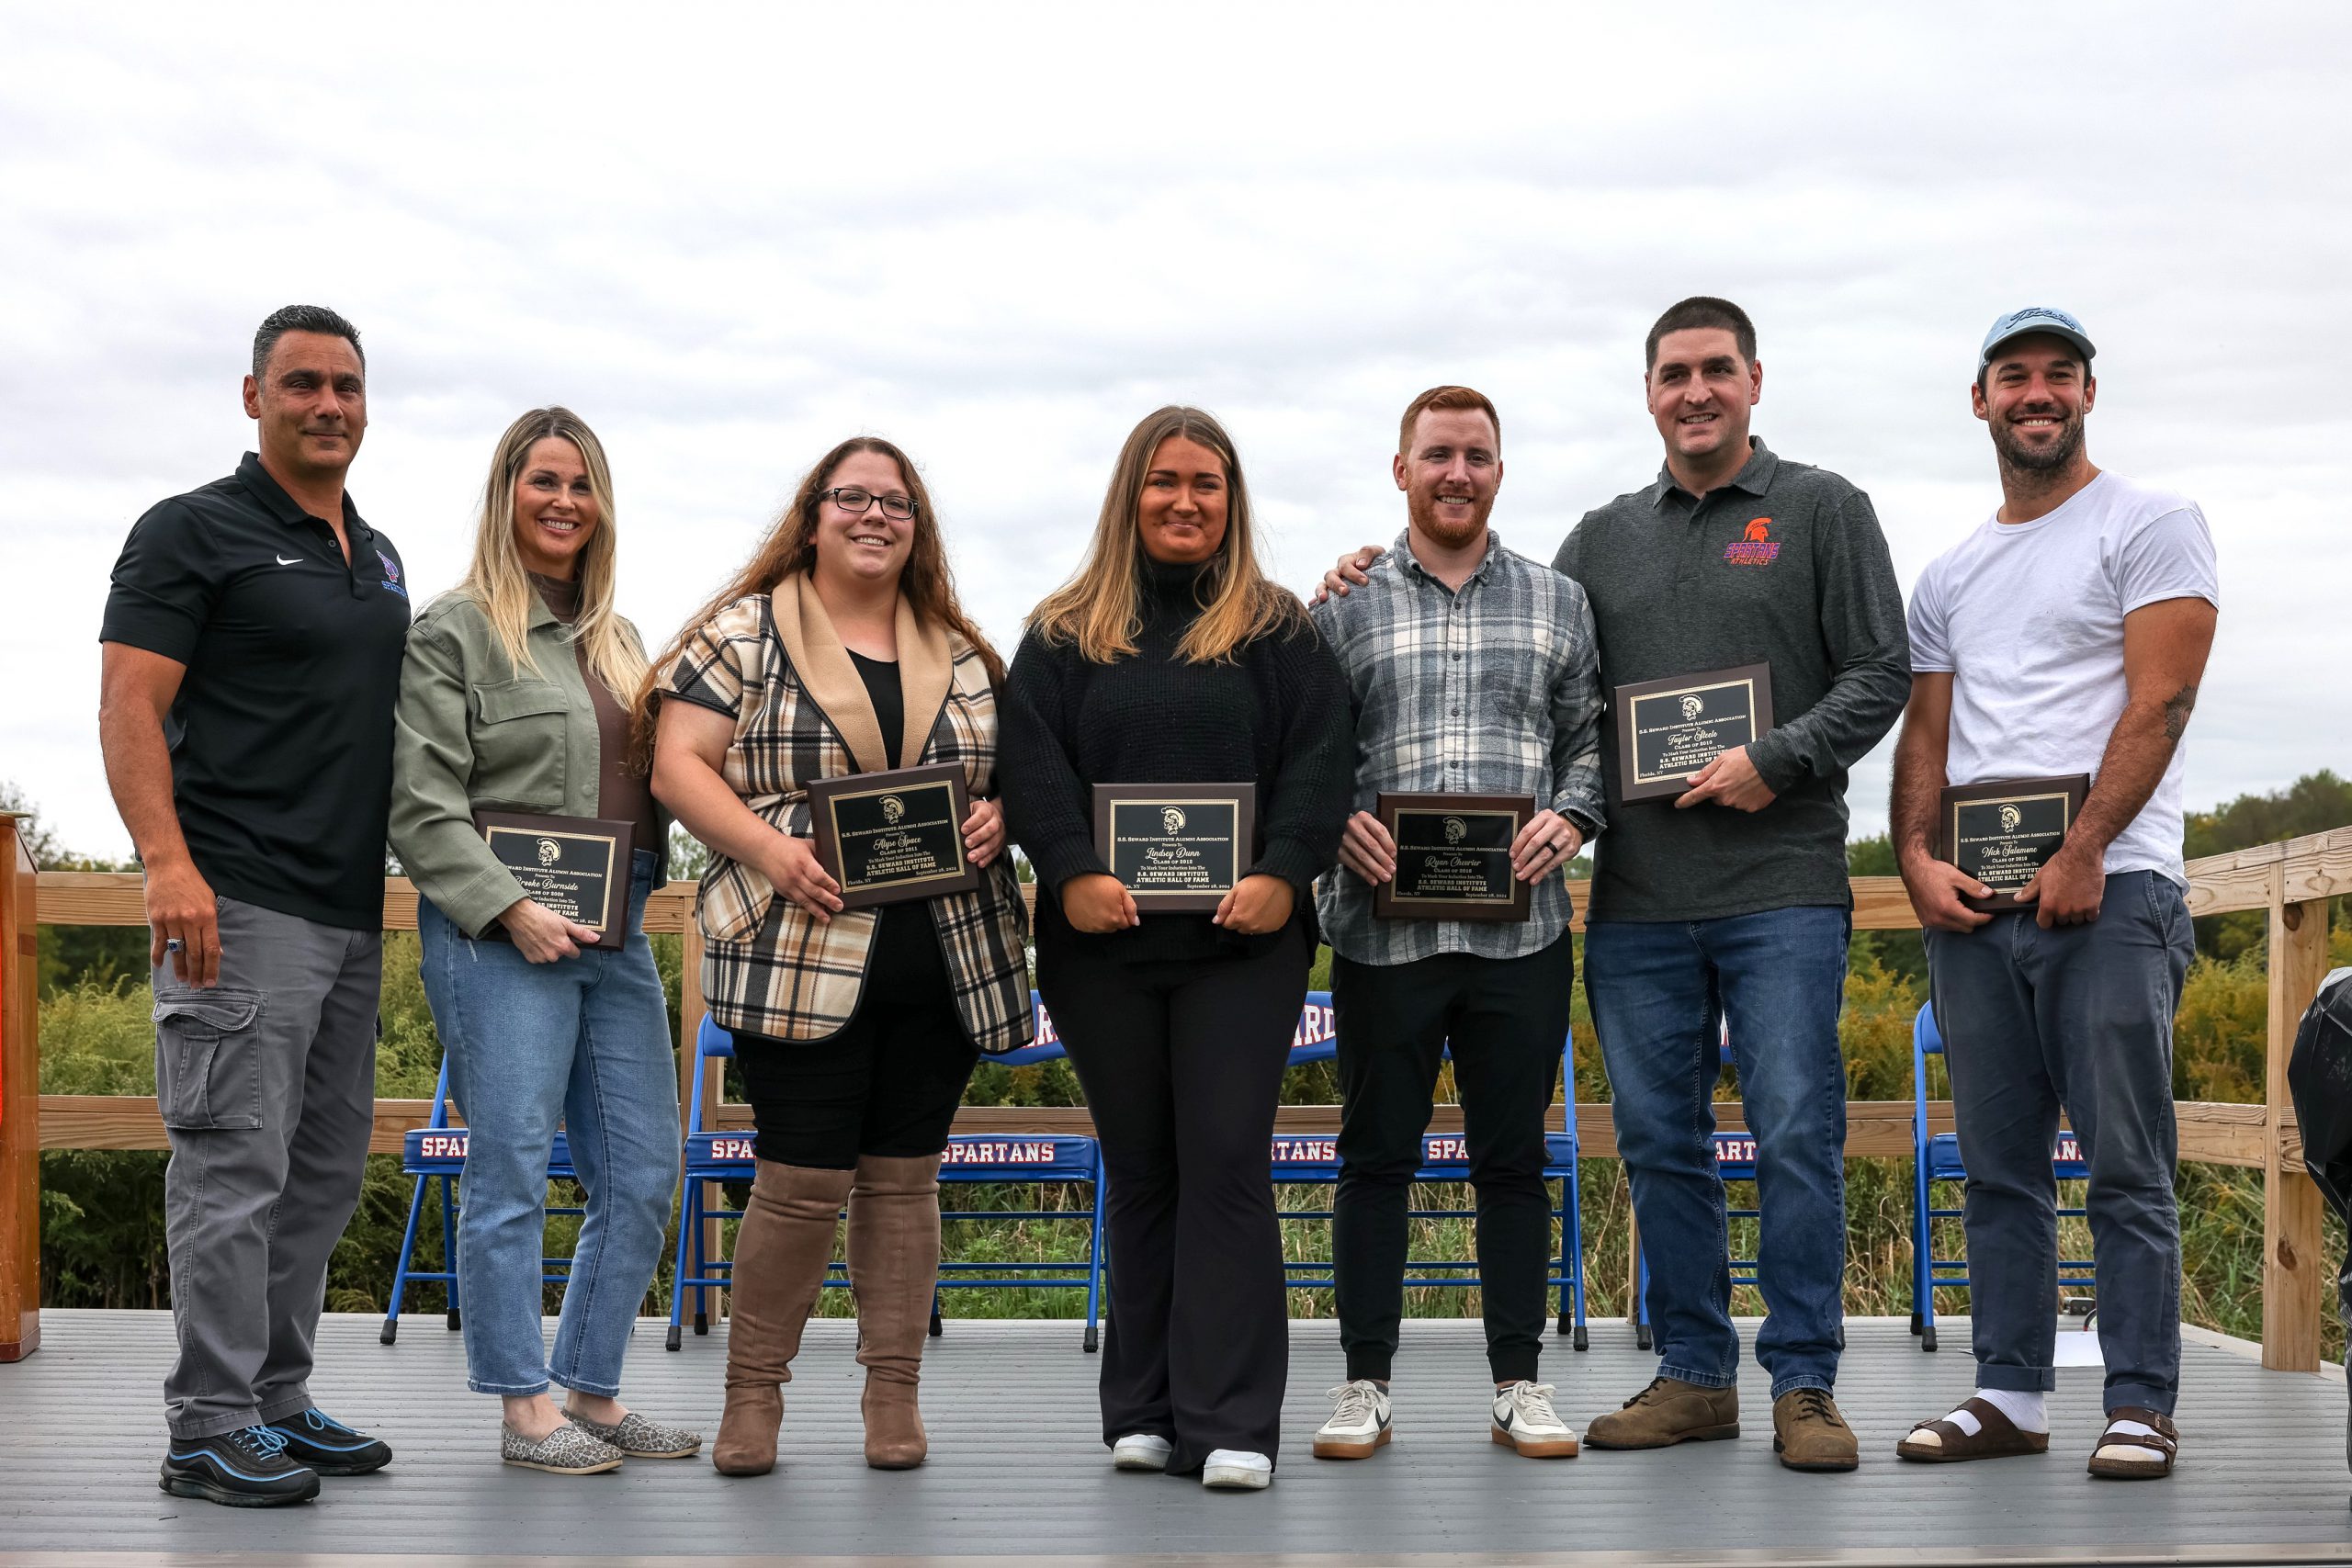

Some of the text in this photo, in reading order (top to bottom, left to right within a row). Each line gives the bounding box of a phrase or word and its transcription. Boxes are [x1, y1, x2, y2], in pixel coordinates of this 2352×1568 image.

[1724, 542, 1781, 559] SPARTANS
[1668, 729, 1718, 745] Taylor Steele
[1659, 761, 1687, 769] ATHLETIC
[873, 838, 896, 850] Alyse
[896, 833, 921, 847] Space
[1145, 847, 1200, 860] Lindsey Dunn
[1425, 856, 1449, 868] Ryan
[542, 879, 578, 891] Burnside
[941, 1143, 1054, 1162] SPARTANS
[1272, 1141, 1336, 1161] TANS
